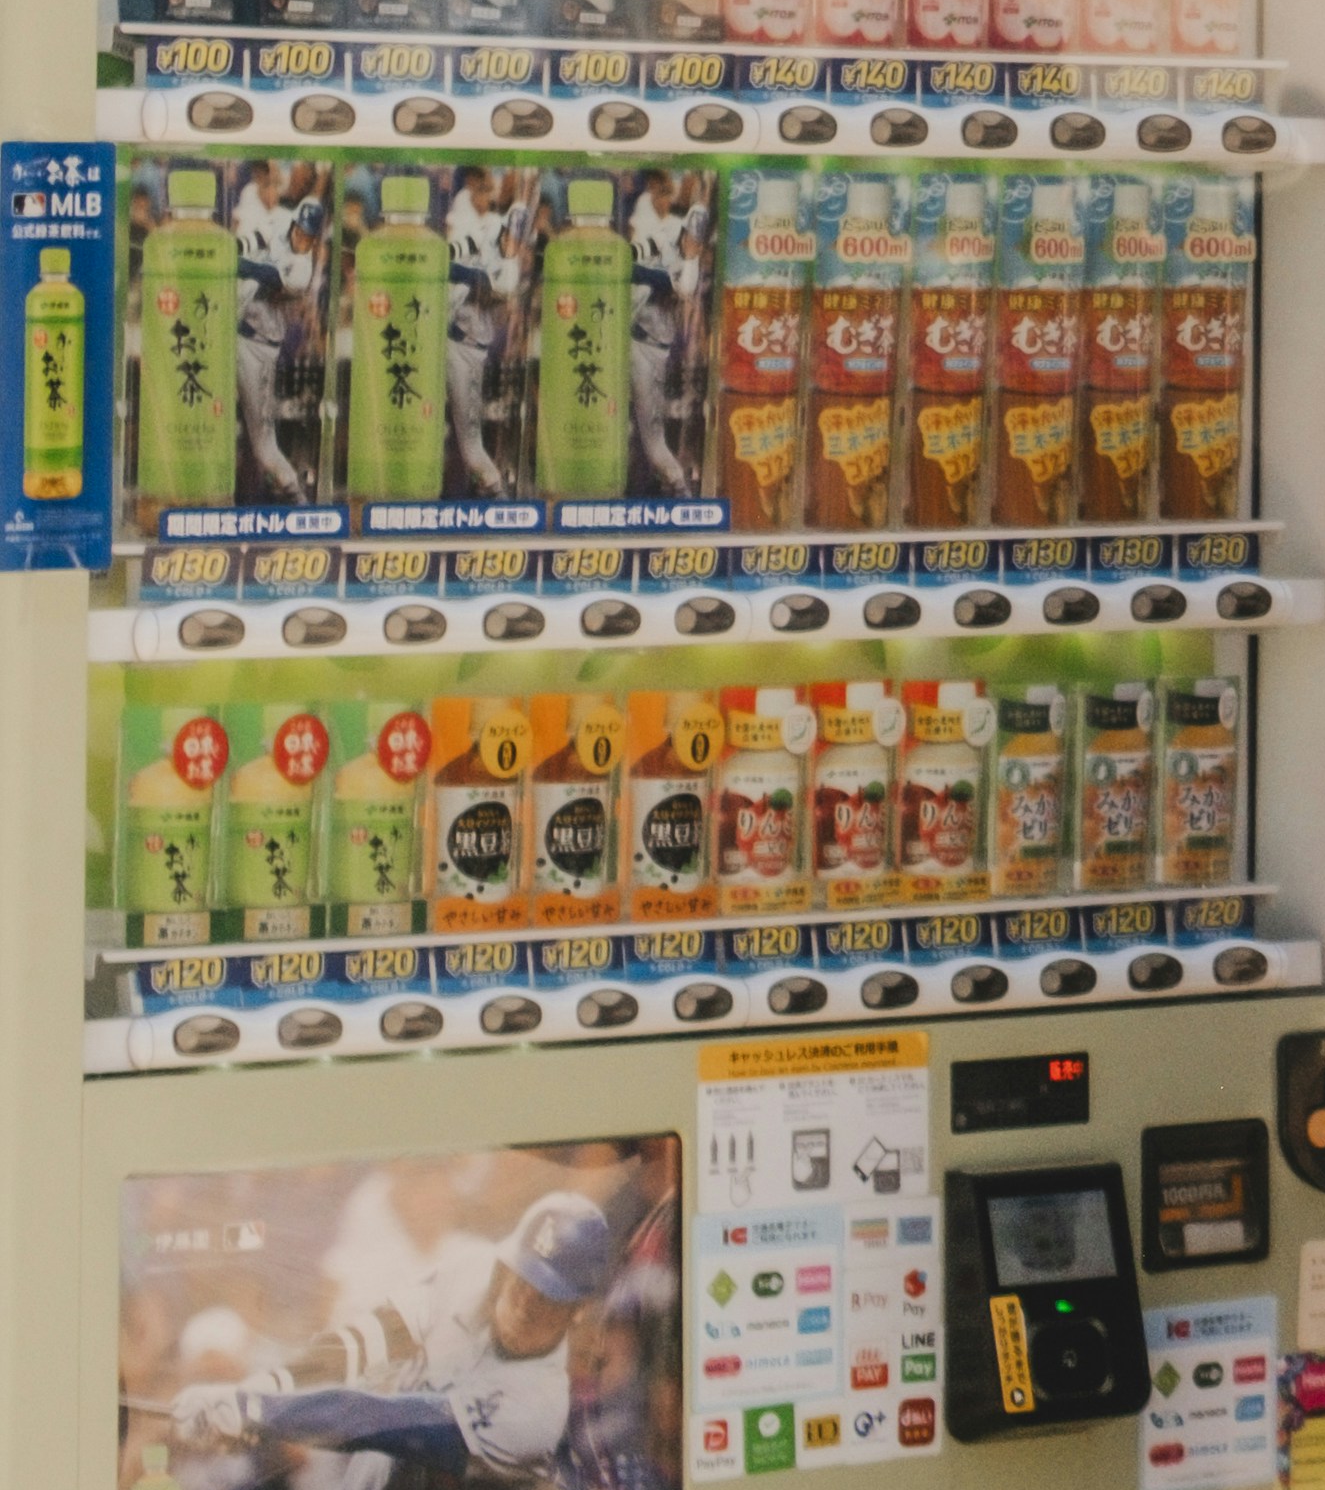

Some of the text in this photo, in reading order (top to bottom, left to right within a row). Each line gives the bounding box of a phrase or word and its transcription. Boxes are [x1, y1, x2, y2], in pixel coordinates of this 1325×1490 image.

[157, 40, 232, 73] ¥100
[260, 43, 332, 76] ¥100
[361, 46, 432, 80] ¥100
[460, 49, 533, 83] ¥100
[559, 51, 630, 85] ¥100
[655, 54, 724, 88] ¥100
[750, 57, 820, 91] ¥140
[840, 59, 907, 93] ¥140
[930, 61, 996, 94] ¥140
[1017, 63, 1081, 96] ¥140
[1105, 65, 1169, 98] ¥140
[1195, 68, 1257, 101] ¥140
[51, 193, 102, 217] MLB
[755, 233, 814, 256] 600ml
[842, 235, 908, 258] 600ml
[949, 236, 993, 258] 600ml
[1034, 237, 1084, 259] 600ml
[1116, 235, 1163, 258] 600ml
[1190, 235, 1253, 258] 600ml
[171, 319, 214, 409] お茶
[380, 322, 422, 410] お茶
[567, 324, 607, 409] お茶
[167, 511, 286, 538] 期間限定ボトル
[370, 505, 483, 531] 期間限定ボトル
[561, 502, 670, 528] 期間限定ボトル
[356, 549, 430, 581] ¥130
[455, 549, 527, 581] ¥130
[552, 546, 623, 580] ¥130
[648, 545, 718, 578] ¥130
[742, 543, 809, 575] ¥130
[832, 543, 899, 574] ¥130
[923, 541, 988, 571] ¥130
[1013, 538, 1076, 569] ¥130
[1101, 536, 1163, 567] ¥130
[1187, 534, 1250, 565] ¥130
[152, 548, 231, 587] ¥130
[255, 549, 330, 585] ¥130
[488, 724, 527, 736] カフェイン
[585, 721, 621, 735] カフェイン
[682, 718, 720, 732] カフェイン
[1006, 907, 1070, 943] ¥120
[1092, 904, 1156, 940] ¥120
[1182, 894, 1245, 929] ¥120
[633, 929, 705, 967] ¥120
[733, 925, 801, 960] ¥120
[826, 920, 892, 955] ¥120
[915, 914, 981, 950] ¥120
[251, 950, 325, 991] ¥120
[346, 945, 419, 984] ¥120
[445, 941, 516, 978] ¥120
[541, 937, 613, 974] ¥120
[152, 954, 227, 996] ¥120
[1049, 1059, 1083, 1081] 販売中
[902, 1302, 926, 1317] Pay
[902, 1332, 936, 1350] LINE
[904, 1359, 933, 1377] Pay
[696, 1456, 736, 1469] PayPay
